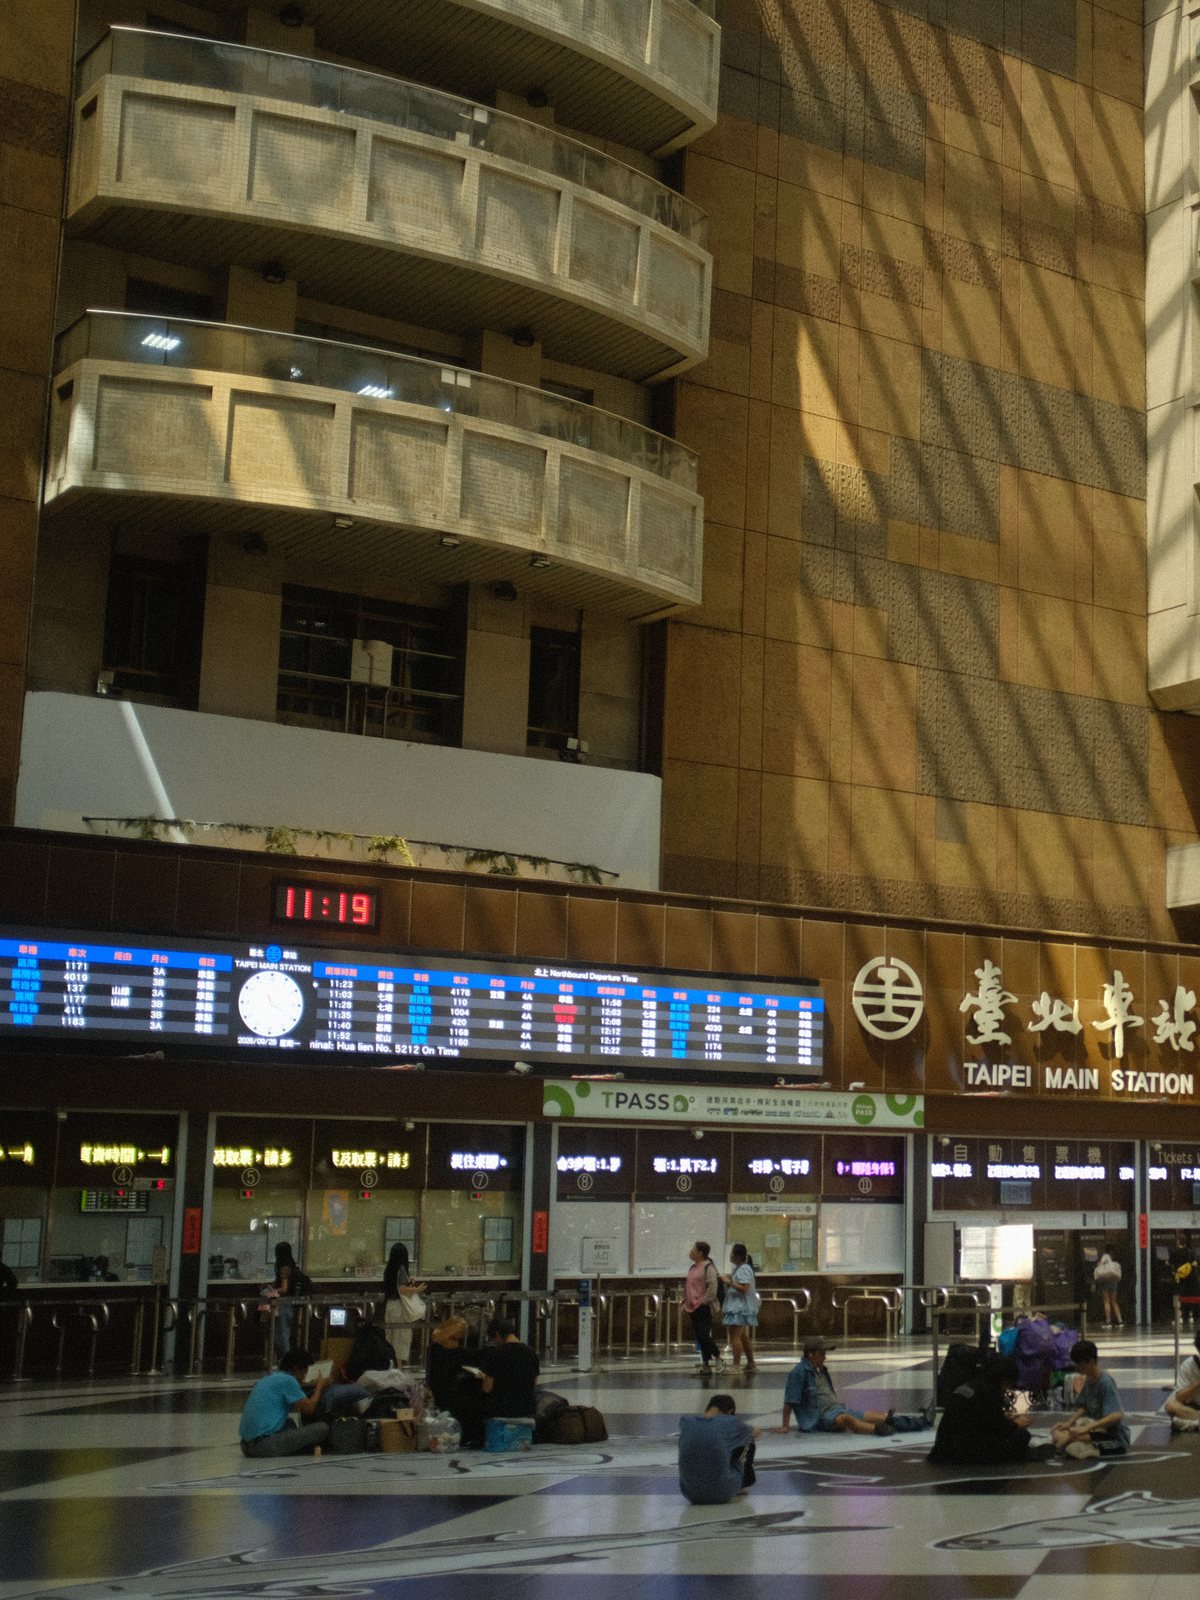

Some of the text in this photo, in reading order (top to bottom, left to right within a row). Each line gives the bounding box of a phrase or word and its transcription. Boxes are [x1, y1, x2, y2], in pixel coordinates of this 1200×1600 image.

[286, 887, 370, 924] 11:19
[151, 954, 168, 964] 月台
[235, 960, 311, 972] TAIPEI MAIN STATION
[65, 961, 88, 970] 1171
[153, 967, 166, 976] 3A
[550, 969, 588, 979] Northbound
[589, 972, 621, 982] Departure
[621, 974, 638, 983] Time
[63, 972, 88, 981] 4019
[153, 978, 165, 986] 3B
[66, 984, 84, 993] 137
[152, 989, 164, 998] 3A
[330, 979, 533, 1001] 11:23 4178 4A
[63, 995, 86, 1004] 1177
[151, 1000, 163, 1008] 3B
[329, 990, 353, 999] 11:03
[453, 998, 468, 1006] 110
[521, 1003, 532, 1011] 4B
[329, 1000, 352, 1009] 11:28
[450, 1008, 470, 1016] 1004
[64, 1006, 82, 1015] 411
[150, 1011, 163, 1019] 3B
[601, 1008, 621, 1016] 12:03
[960, 959, 1197, 1058] 臺北車站
[149, 1022, 162, 1030] 3A
[328, 1011, 351, 1020] 11:35
[451, 1018, 467, 1026] 420
[521, 1022, 532, 1030] 4B
[601, 1018, 621, 1026] 12:08
[704, 1024, 722, 1032] 4030
[328, 1021, 351, 1030] 11:40
[520, 1032, 532, 1040] 4A
[600, 1027, 621, 1036] 12:12
[766, 1037, 776, 1045] 4A
[327, 1031, 351, 1040] 11:52
[520, 1042, 531, 1050] 4A
[600, 1037, 620, 1045] 12:17
[336, 1043, 355, 1051] Hua
[358, 1043, 374, 1052] lien
[375, 1044, 392, 1053] No.
[395, 1045, 419, 1054] 5212
[421, 1046, 435, 1055] On
[437, 1047, 459, 1056] Time
[600, 1046, 620, 1055] 12:22
[704, 1052, 722, 1060] 1170
[766, 1055, 776, 1063] 4A
[963, 1062, 1194, 1095] TAIPEI MAIN STATION
[602, 1091, 669, 1110] TPASS
[954, 1144, 1101, 1164] 自動售票機
[1158, 1151, 1192, 1164] Tickets
